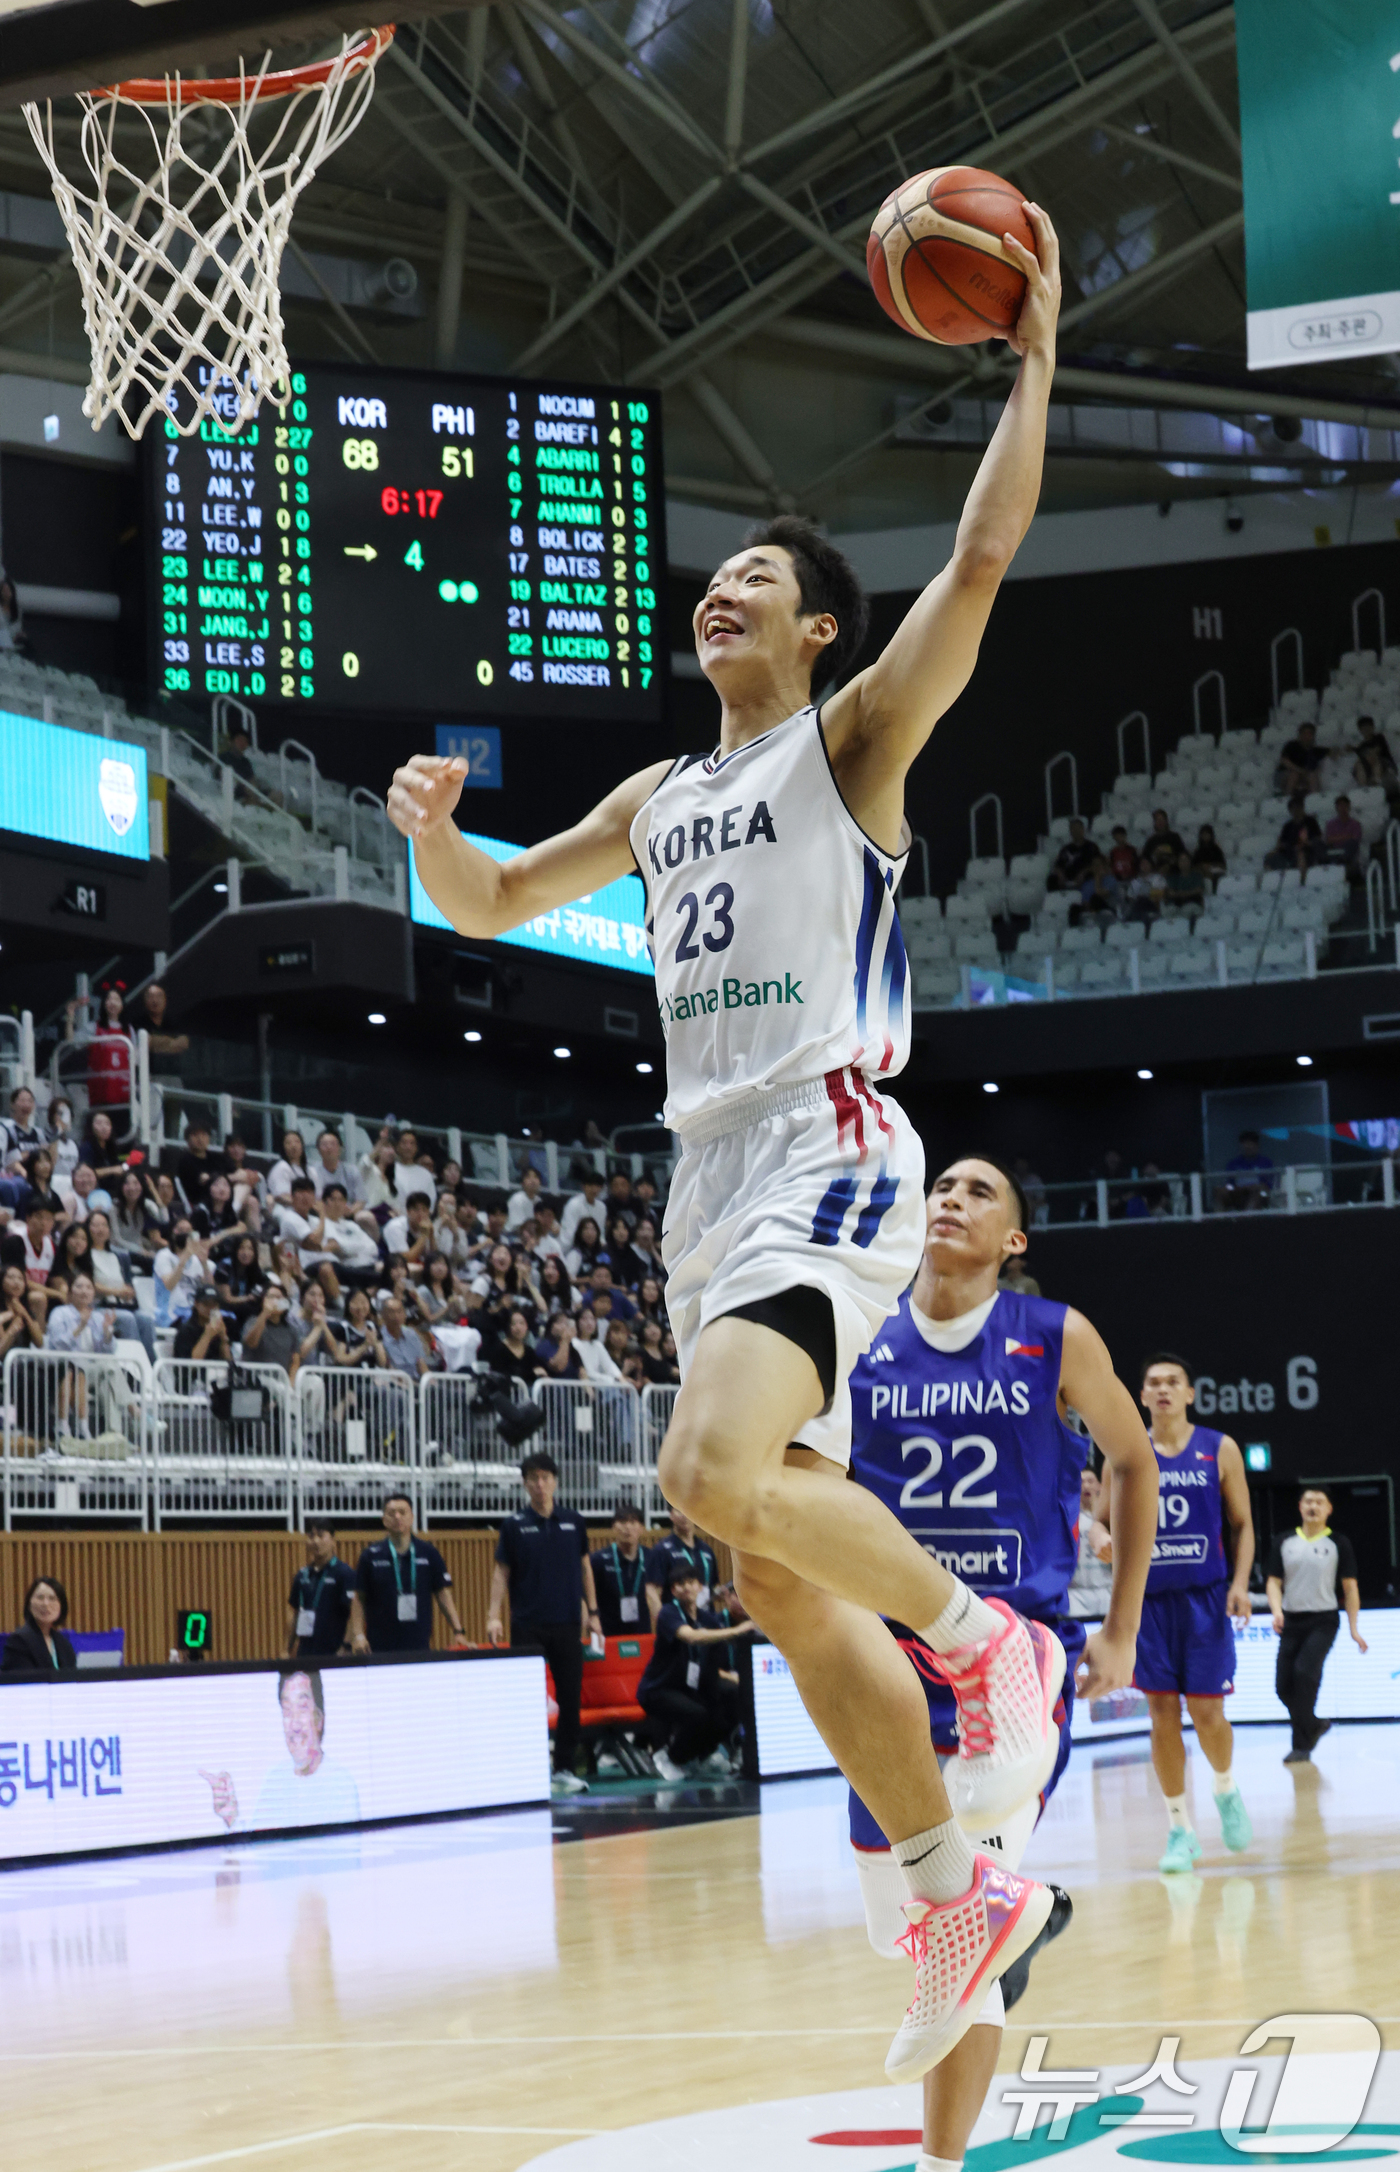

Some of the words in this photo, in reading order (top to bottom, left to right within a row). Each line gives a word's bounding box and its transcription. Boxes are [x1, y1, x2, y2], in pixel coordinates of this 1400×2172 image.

[292, 373, 307, 395] 6
[293, 400, 307, 421] 0
[338, 396, 387, 428] KOR
[432, 403, 475, 436] PHI
[508, 392, 517, 412] 1
[538, 394, 596, 419] NOCUM
[611, 401, 619, 420] 1
[627, 402, 648, 423] 10
[200, 420, 259, 446] LEE.J
[275, 426, 289, 449] 2
[289, 427, 313, 449] 27
[506, 418, 520, 439] 2
[534, 420, 599, 445] BAREFI
[609, 427, 621, 447] 4
[631, 428, 644, 450] 2
[166, 444, 179, 466] 7
[206, 448, 255, 473] YU.K
[275, 454, 289, 475] 0
[294, 455, 308, 476] 0
[343, 438, 379, 471] 68
[442, 446, 473, 478] 51
[507, 445, 520, 465] 4
[536, 446, 600, 473] ABARRI
[613, 454, 621, 473] 1
[631, 455, 645, 476] 0
[166, 472, 180, 494] 8
[207, 476, 255, 500] AN.Y
[279, 481, 287, 502] 1
[295, 482, 309, 504] 3
[381, 487, 443, 518] 6:17
[508, 472, 522, 493] 6
[537, 472, 605, 499] TROLLA
[614, 480, 622, 499] 1
[633, 481, 646, 502] 5
[164, 500, 184, 522] 11
[202, 503, 262, 528] LEE.W
[276, 508, 291, 530] 0
[296, 510, 310, 532] 0
[510, 498, 522, 518] 7
[537, 499, 602, 525] AHANMI
[612, 506, 625, 527] 0
[634, 508, 647, 529] 3
[162, 527, 187, 551] 22
[202, 530, 261, 556] YEO.J
[281, 537, 289, 557] 1
[296, 537, 311, 558] 8
[404, 540, 424, 571] 4
[509, 525, 524, 547] 8
[538, 525, 606, 553] BOLICK
[613, 533, 626, 554] 2
[635, 535, 648, 556] 2
[162, 556, 188, 578] 23
[203, 559, 263, 584] LEE.W
[278, 563, 292, 585] 2
[297, 565, 311, 586] 4
[509, 552, 529, 573] 17
[544, 554, 601, 579] BATES
[614, 560, 627, 580] 2
[635, 561, 649, 582] 0
[163, 583, 188, 606] 24
[198, 586, 269, 612] MOON.Y
[282, 592, 290, 612] 1
[298, 592, 312, 614] 6
[510, 580, 531, 601] 19
[540, 581, 607, 606] BALTAZ
[615, 586, 628, 607] 2
[635, 588, 656, 609] 13
[164, 611, 187, 634] 31
[200, 614, 269, 640] JANG.J
[283, 620, 291, 640] 1
[299, 620, 313, 641] 3
[507, 606, 530, 628] 21
[546, 608, 603, 632] ARANA
[615, 614, 629, 634] 0
[637, 615, 651, 636] 6
[1192, 606, 1223, 640] H1
[164, 640, 190, 662] 33
[205, 642, 265, 667] LEE.S
[280, 647, 294, 668] 2
[299, 647, 314, 669] 6
[508, 633, 533, 655] 22
[541, 636, 610, 660] LUCERO
[617, 640, 630, 661] 2
[639, 641, 652, 662] 3
[165, 668, 190, 690] 36
[206, 670, 266, 695] EDI.D
[281, 675, 295, 697] 2
[300, 676, 314, 698] 5
[342, 652, 359, 677] 0
[477, 660, 493, 685] 0
[509, 661, 534, 682] 45
[543, 662, 610, 687] ROSSER
[621, 667, 629, 688] 1
[640, 668, 652, 689] 7
[648, 800, 778, 881] KOREA
[76, 886, 97, 914] R1
[675, 881, 735, 964] 23
[871, 1379, 1031, 1421] PILIPINAS
[1193, 1376, 1275, 1416] Gate
[1286, 1355, 1319, 1411] 6
[899, 1433, 998, 1509] 22
[1158, 1493, 1190, 1530] 19
[1160, 1541, 1202, 1558] Smart
[184, 1612, 207, 1648] 0
[0, 1734, 123, 1808] 동나비엔
